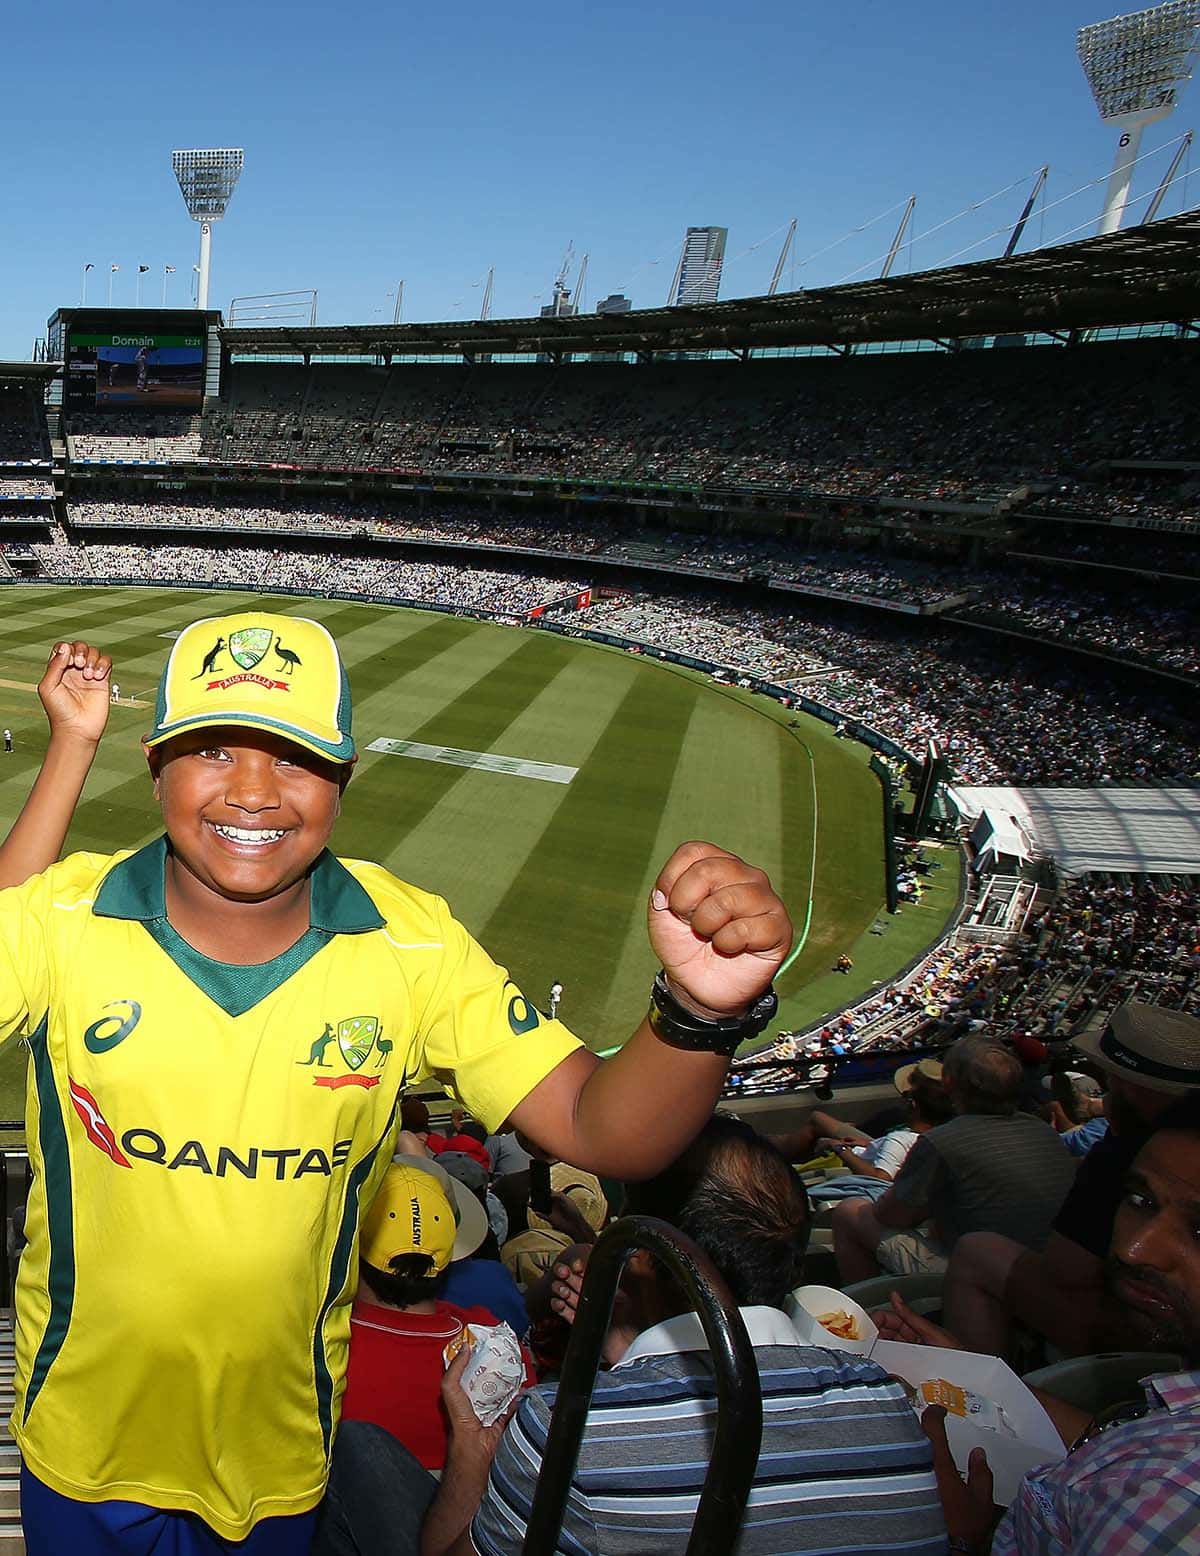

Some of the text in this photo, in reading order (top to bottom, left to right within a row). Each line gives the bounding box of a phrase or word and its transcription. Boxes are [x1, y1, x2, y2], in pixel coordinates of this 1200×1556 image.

[1119, 133, 1131, 147] 6
[202, 225, 209, 235] 5
[111, 335, 154, 346] Domain
[223, 674, 271, 687] AUSTRALIA
[121, 1128, 353, 1181] QANTAS
[409, 1197, 422, 1246] AUSTRALIA
